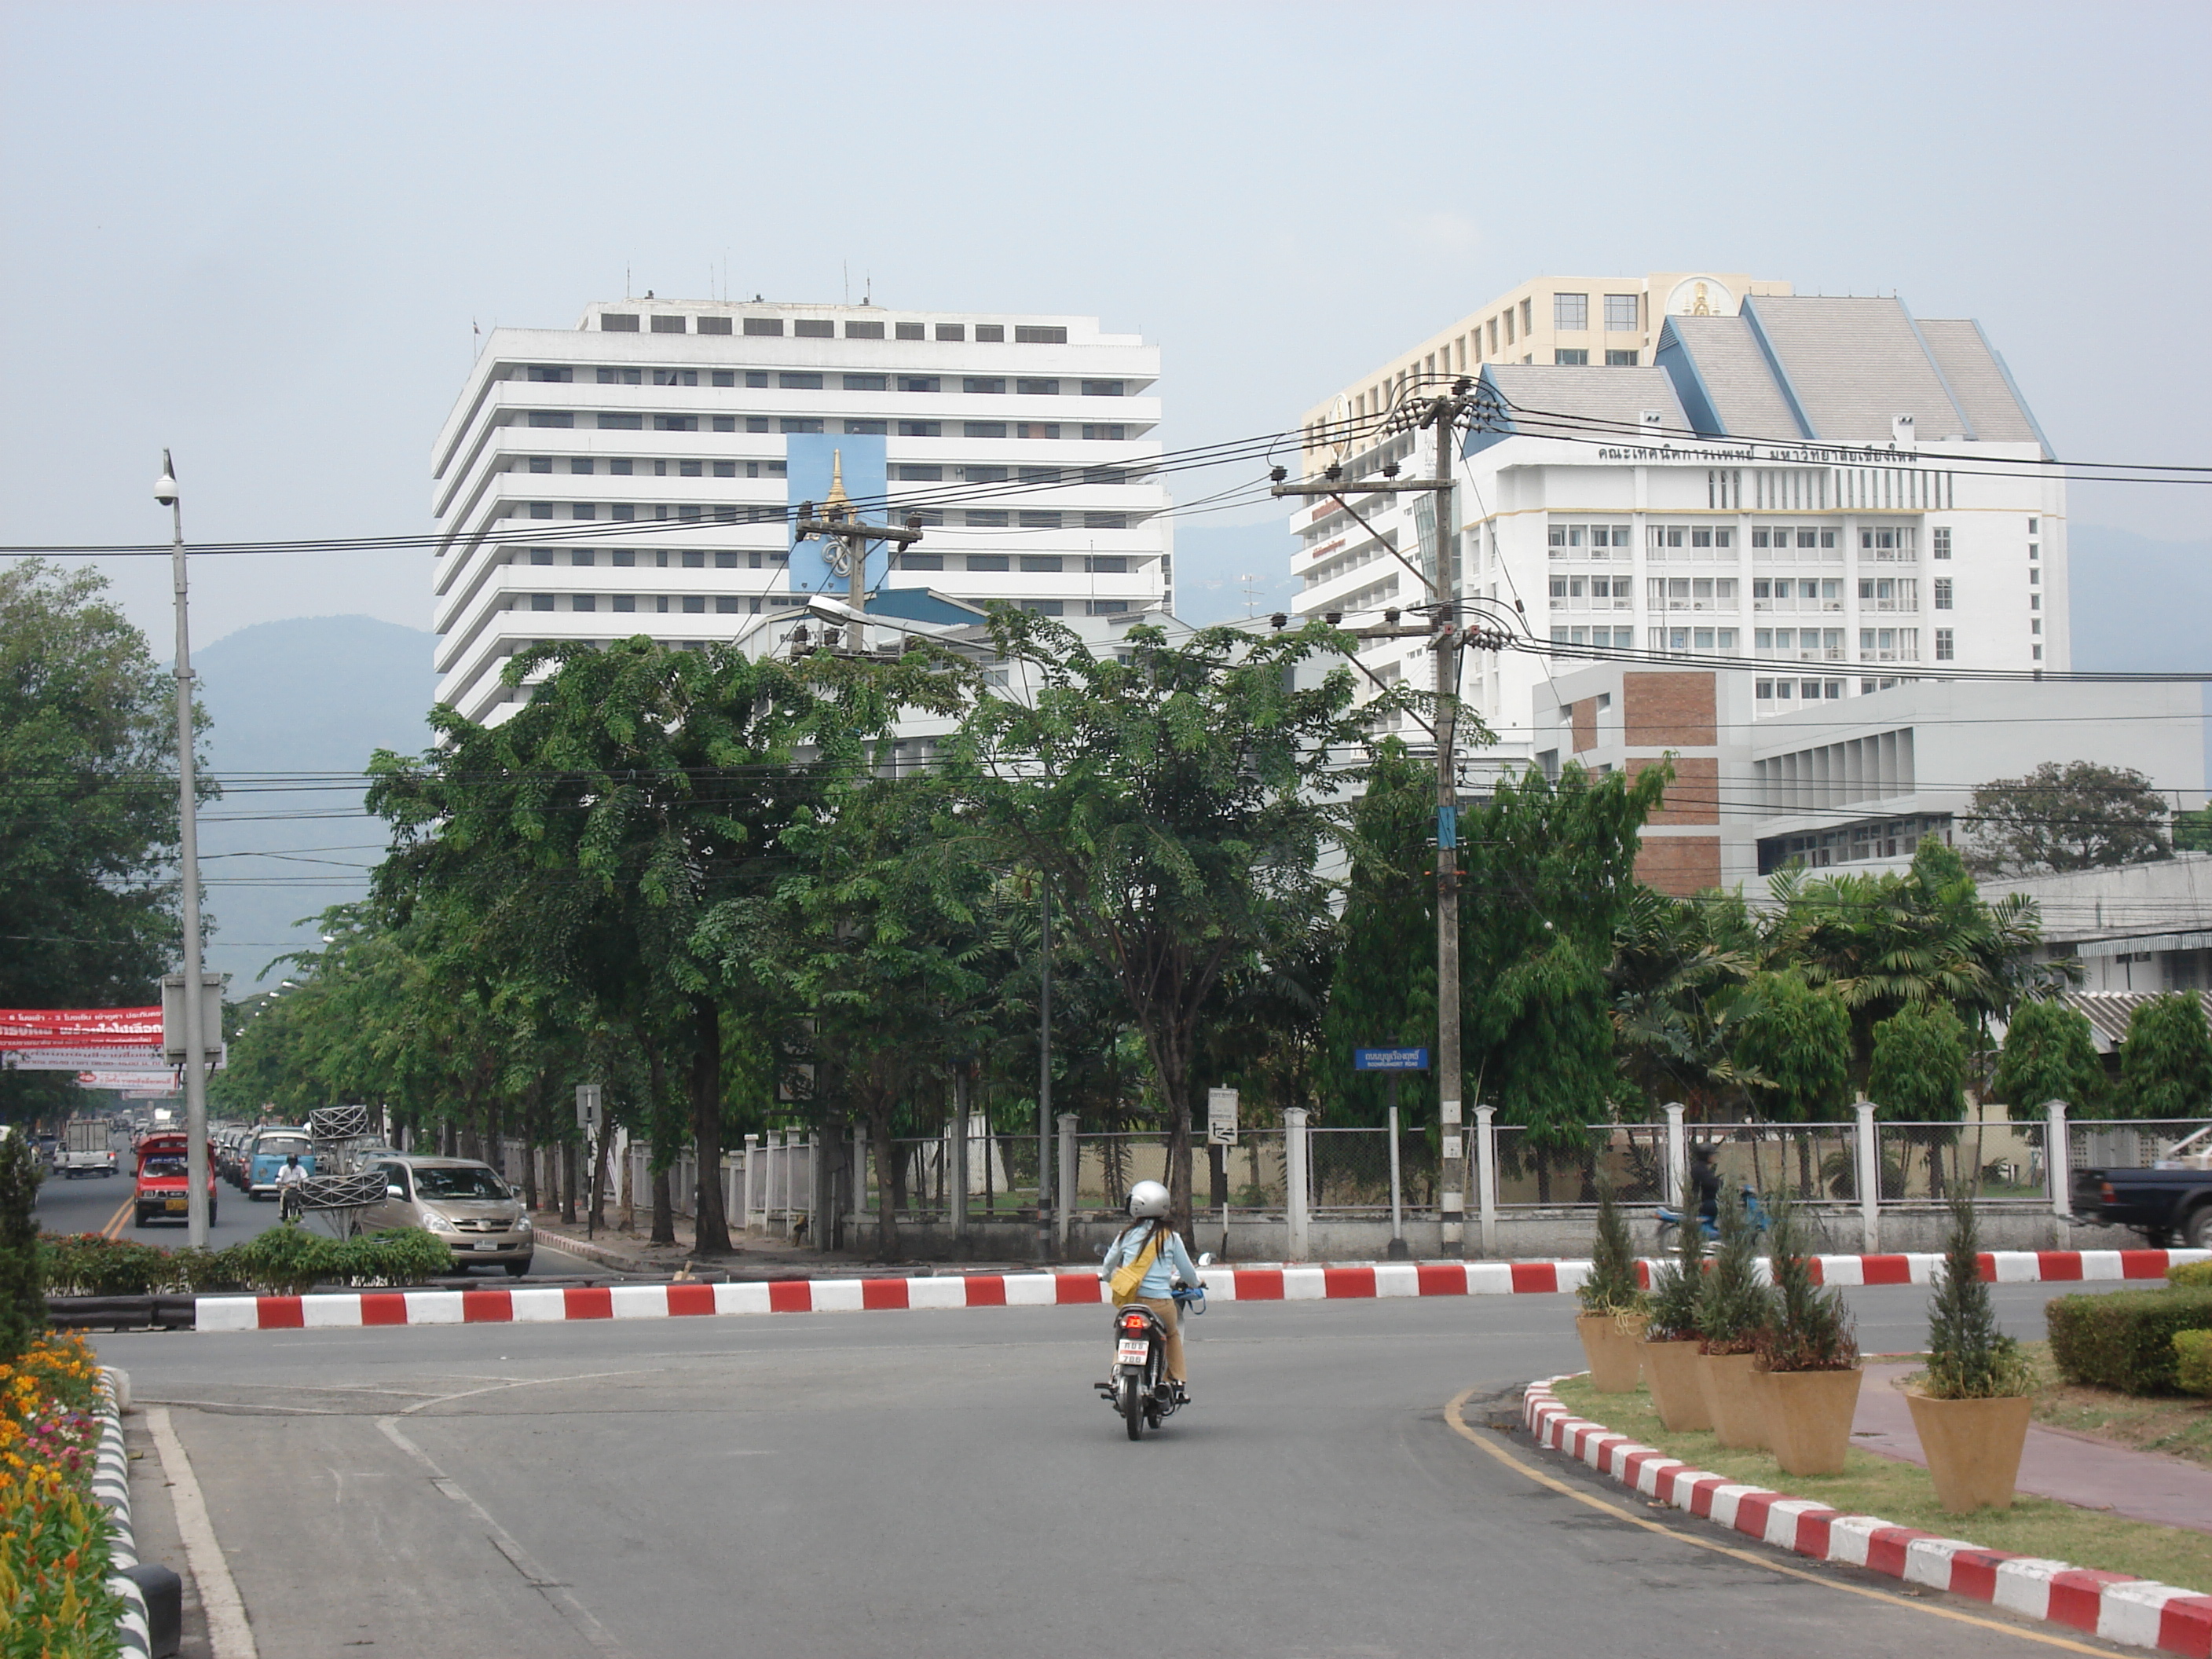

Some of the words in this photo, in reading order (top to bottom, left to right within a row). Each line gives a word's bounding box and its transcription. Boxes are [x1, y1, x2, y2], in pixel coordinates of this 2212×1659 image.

[1770, 442, 1917, 463] มหาวิทยาลัยเชียงใหม่
